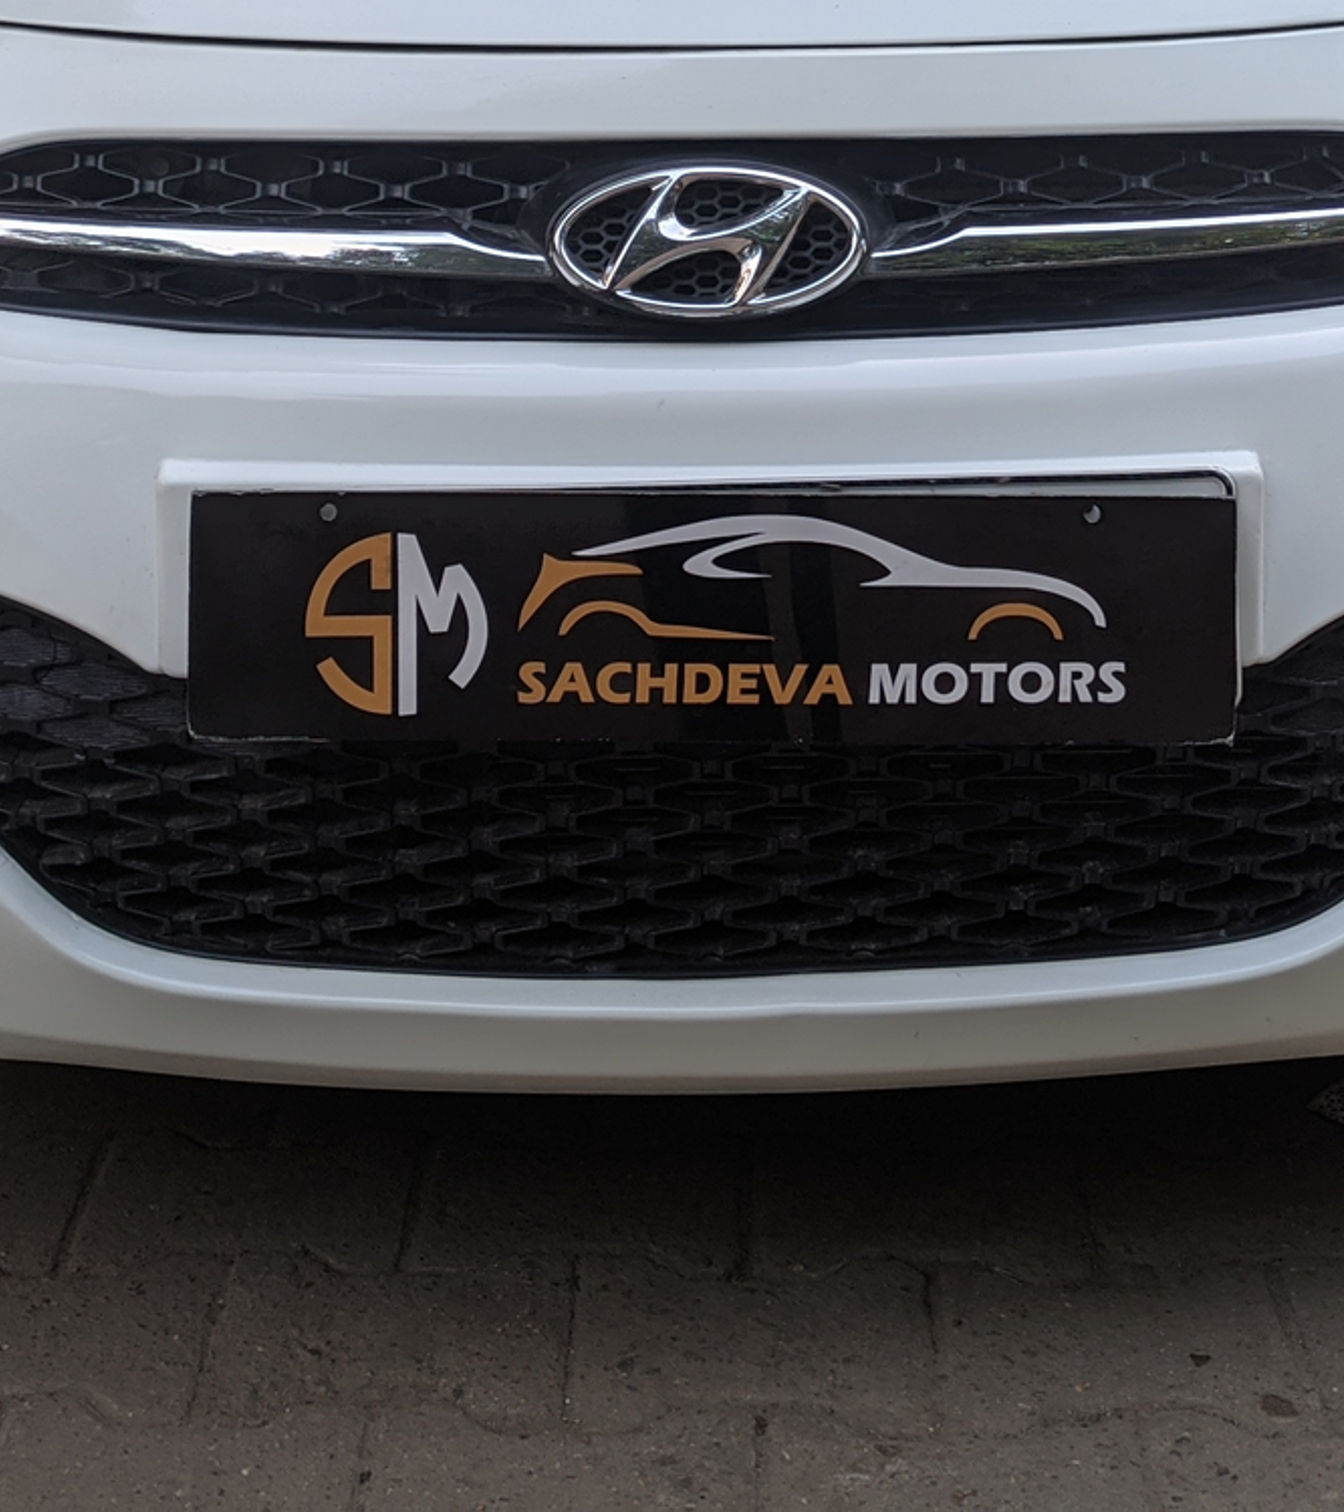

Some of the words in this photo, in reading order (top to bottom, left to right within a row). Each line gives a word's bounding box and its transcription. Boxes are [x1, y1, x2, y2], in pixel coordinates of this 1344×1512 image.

[305, 531, 488, 717] SM
[516, 661, 853, 705] SACHDEVA
[868, 661, 1126, 705] MOTORS
